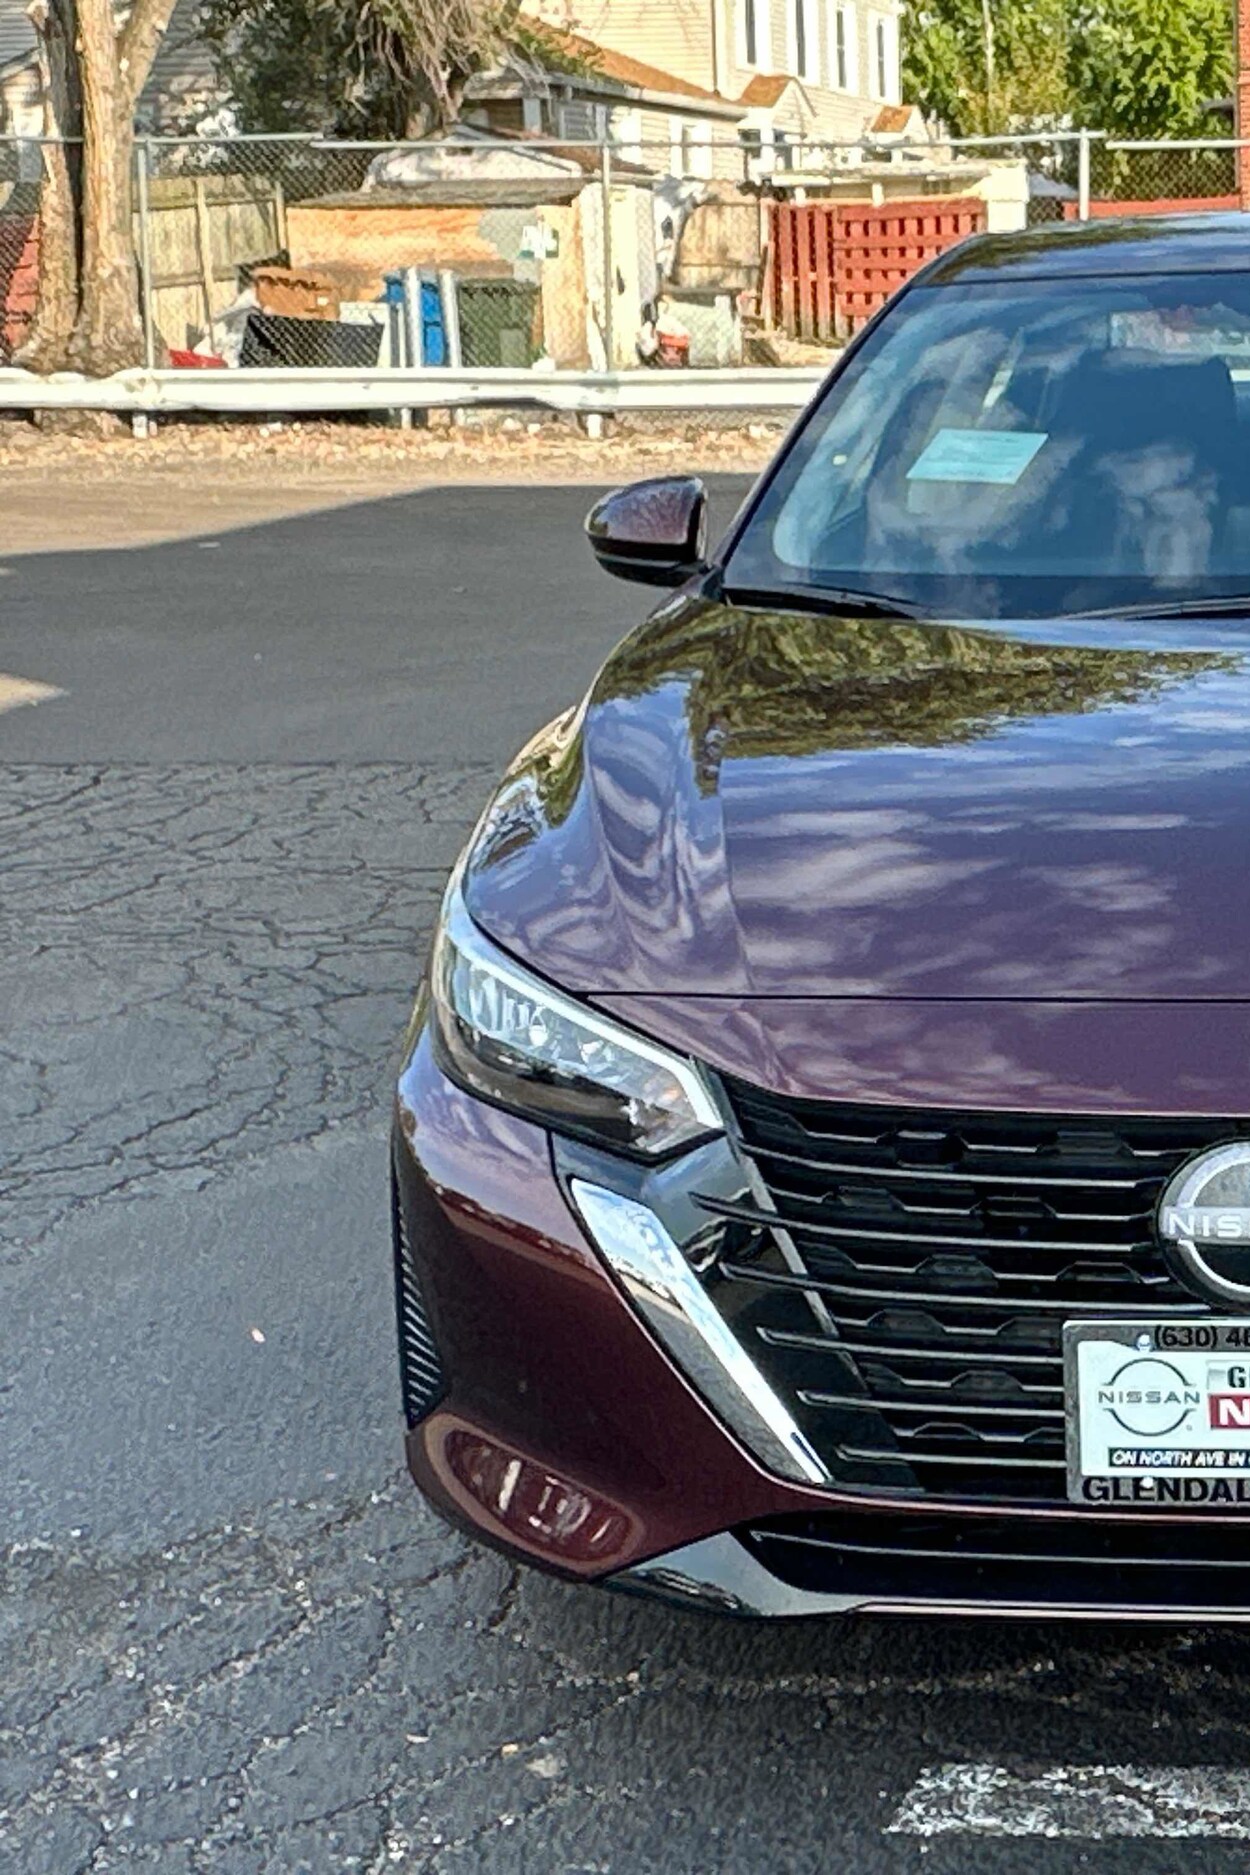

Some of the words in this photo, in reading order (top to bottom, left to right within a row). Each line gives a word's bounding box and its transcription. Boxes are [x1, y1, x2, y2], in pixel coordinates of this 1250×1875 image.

[1154, 1325, 1217, 1349] (630)
[1098, 1390, 1200, 1406] NISSAN
[1112, 1450, 1137, 1466] ON
[1139, 1450, 1194, 1467] NORTH
[1194, 1451, 1225, 1467] AVE
[1228, 1451, 1247, 1467] IN
